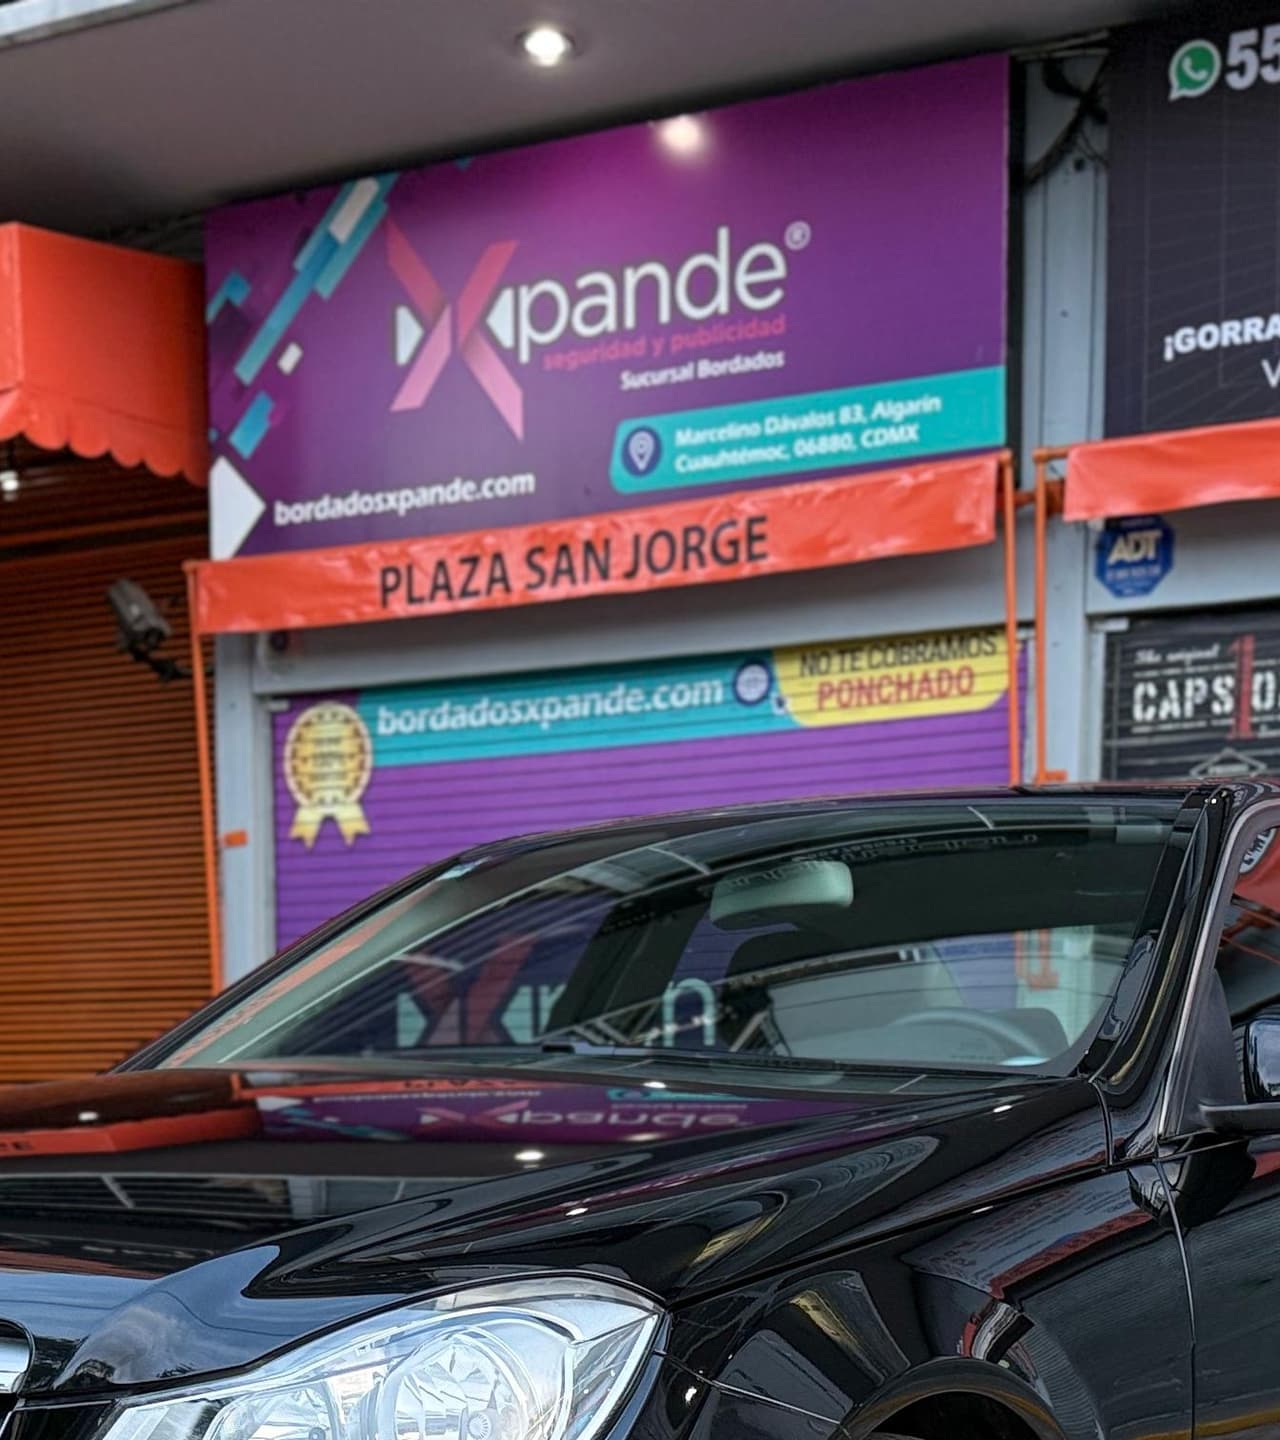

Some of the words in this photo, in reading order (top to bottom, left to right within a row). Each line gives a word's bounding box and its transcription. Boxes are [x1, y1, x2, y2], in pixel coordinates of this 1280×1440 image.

[542, 332, 648, 371] seguridad
[652, 336, 668, 358] y
[671, 314, 787, 354] publicidad
[619, 361, 694, 390] Sucursal
[697, 350, 786, 379] Bordados
[674, 417, 760, 448] Marcelino
[859, 422, 919, 448] CDMX
[273, 472, 536, 527] bordadosxpande.com
[379, 551, 512, 609] PLAZA
[524, 536, 612, 591] SAN
[622, 514, 768, 581] JORGE
[1107, 530, 1163, 565] ADT
[799, 650, 830, 678] NO
[837, 646, 864, 672] TE
[866, 631, 999, 670] COBRAMOS
[376, 678, 724, 736] bordadosxpande.com
[816, 665, 975, 712] PONCHADO
